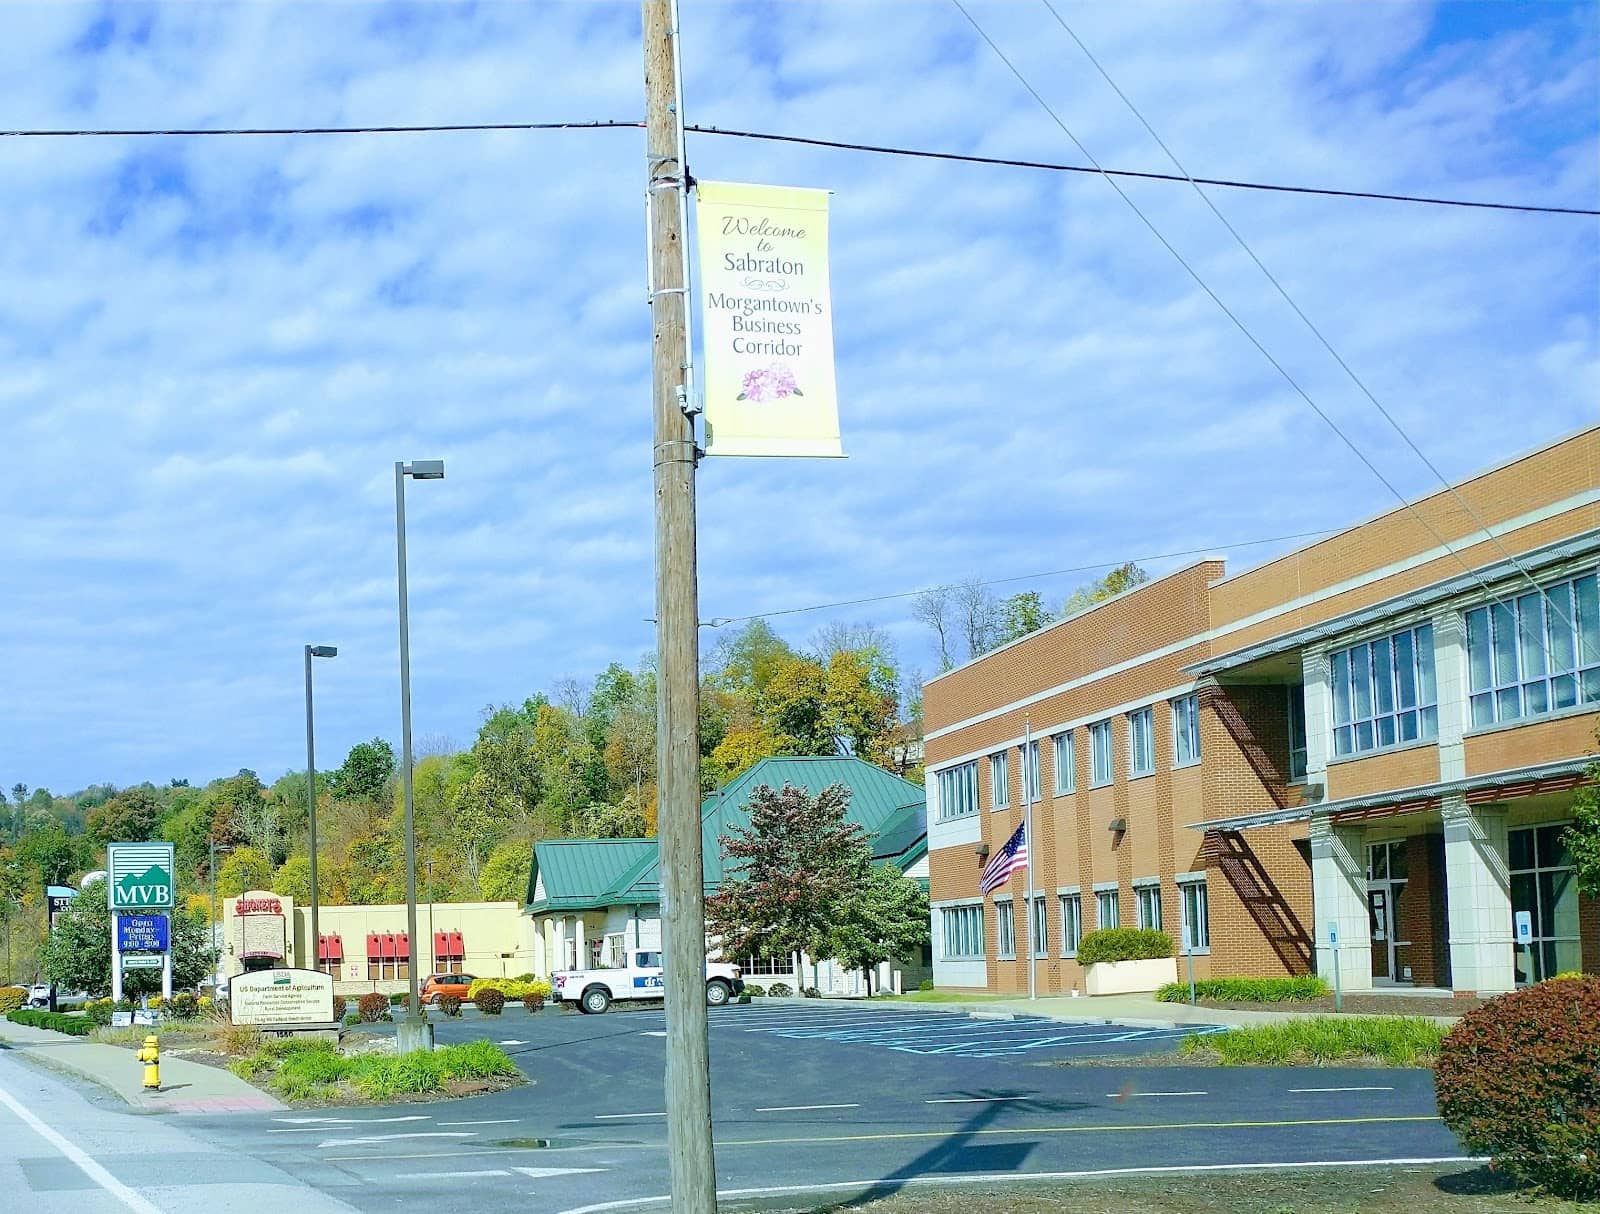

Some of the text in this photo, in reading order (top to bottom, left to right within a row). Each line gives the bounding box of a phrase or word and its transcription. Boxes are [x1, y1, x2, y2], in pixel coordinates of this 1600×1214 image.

[722, 216, 807, 239] Welcome
[757, 238, 774, 252] to
[724, 252, 804, 275] Sabraton
[708, 293, 823, 316] Morgantown's
[733, 315, 801, 335] Business
[733, 337, 803, 356] Corridor
[115, 885, 169, 904] MVB
[131, 919, 153, 928] Open
[129, 933, 156, 941] Friday
[249, 985, 284, 993] Department
